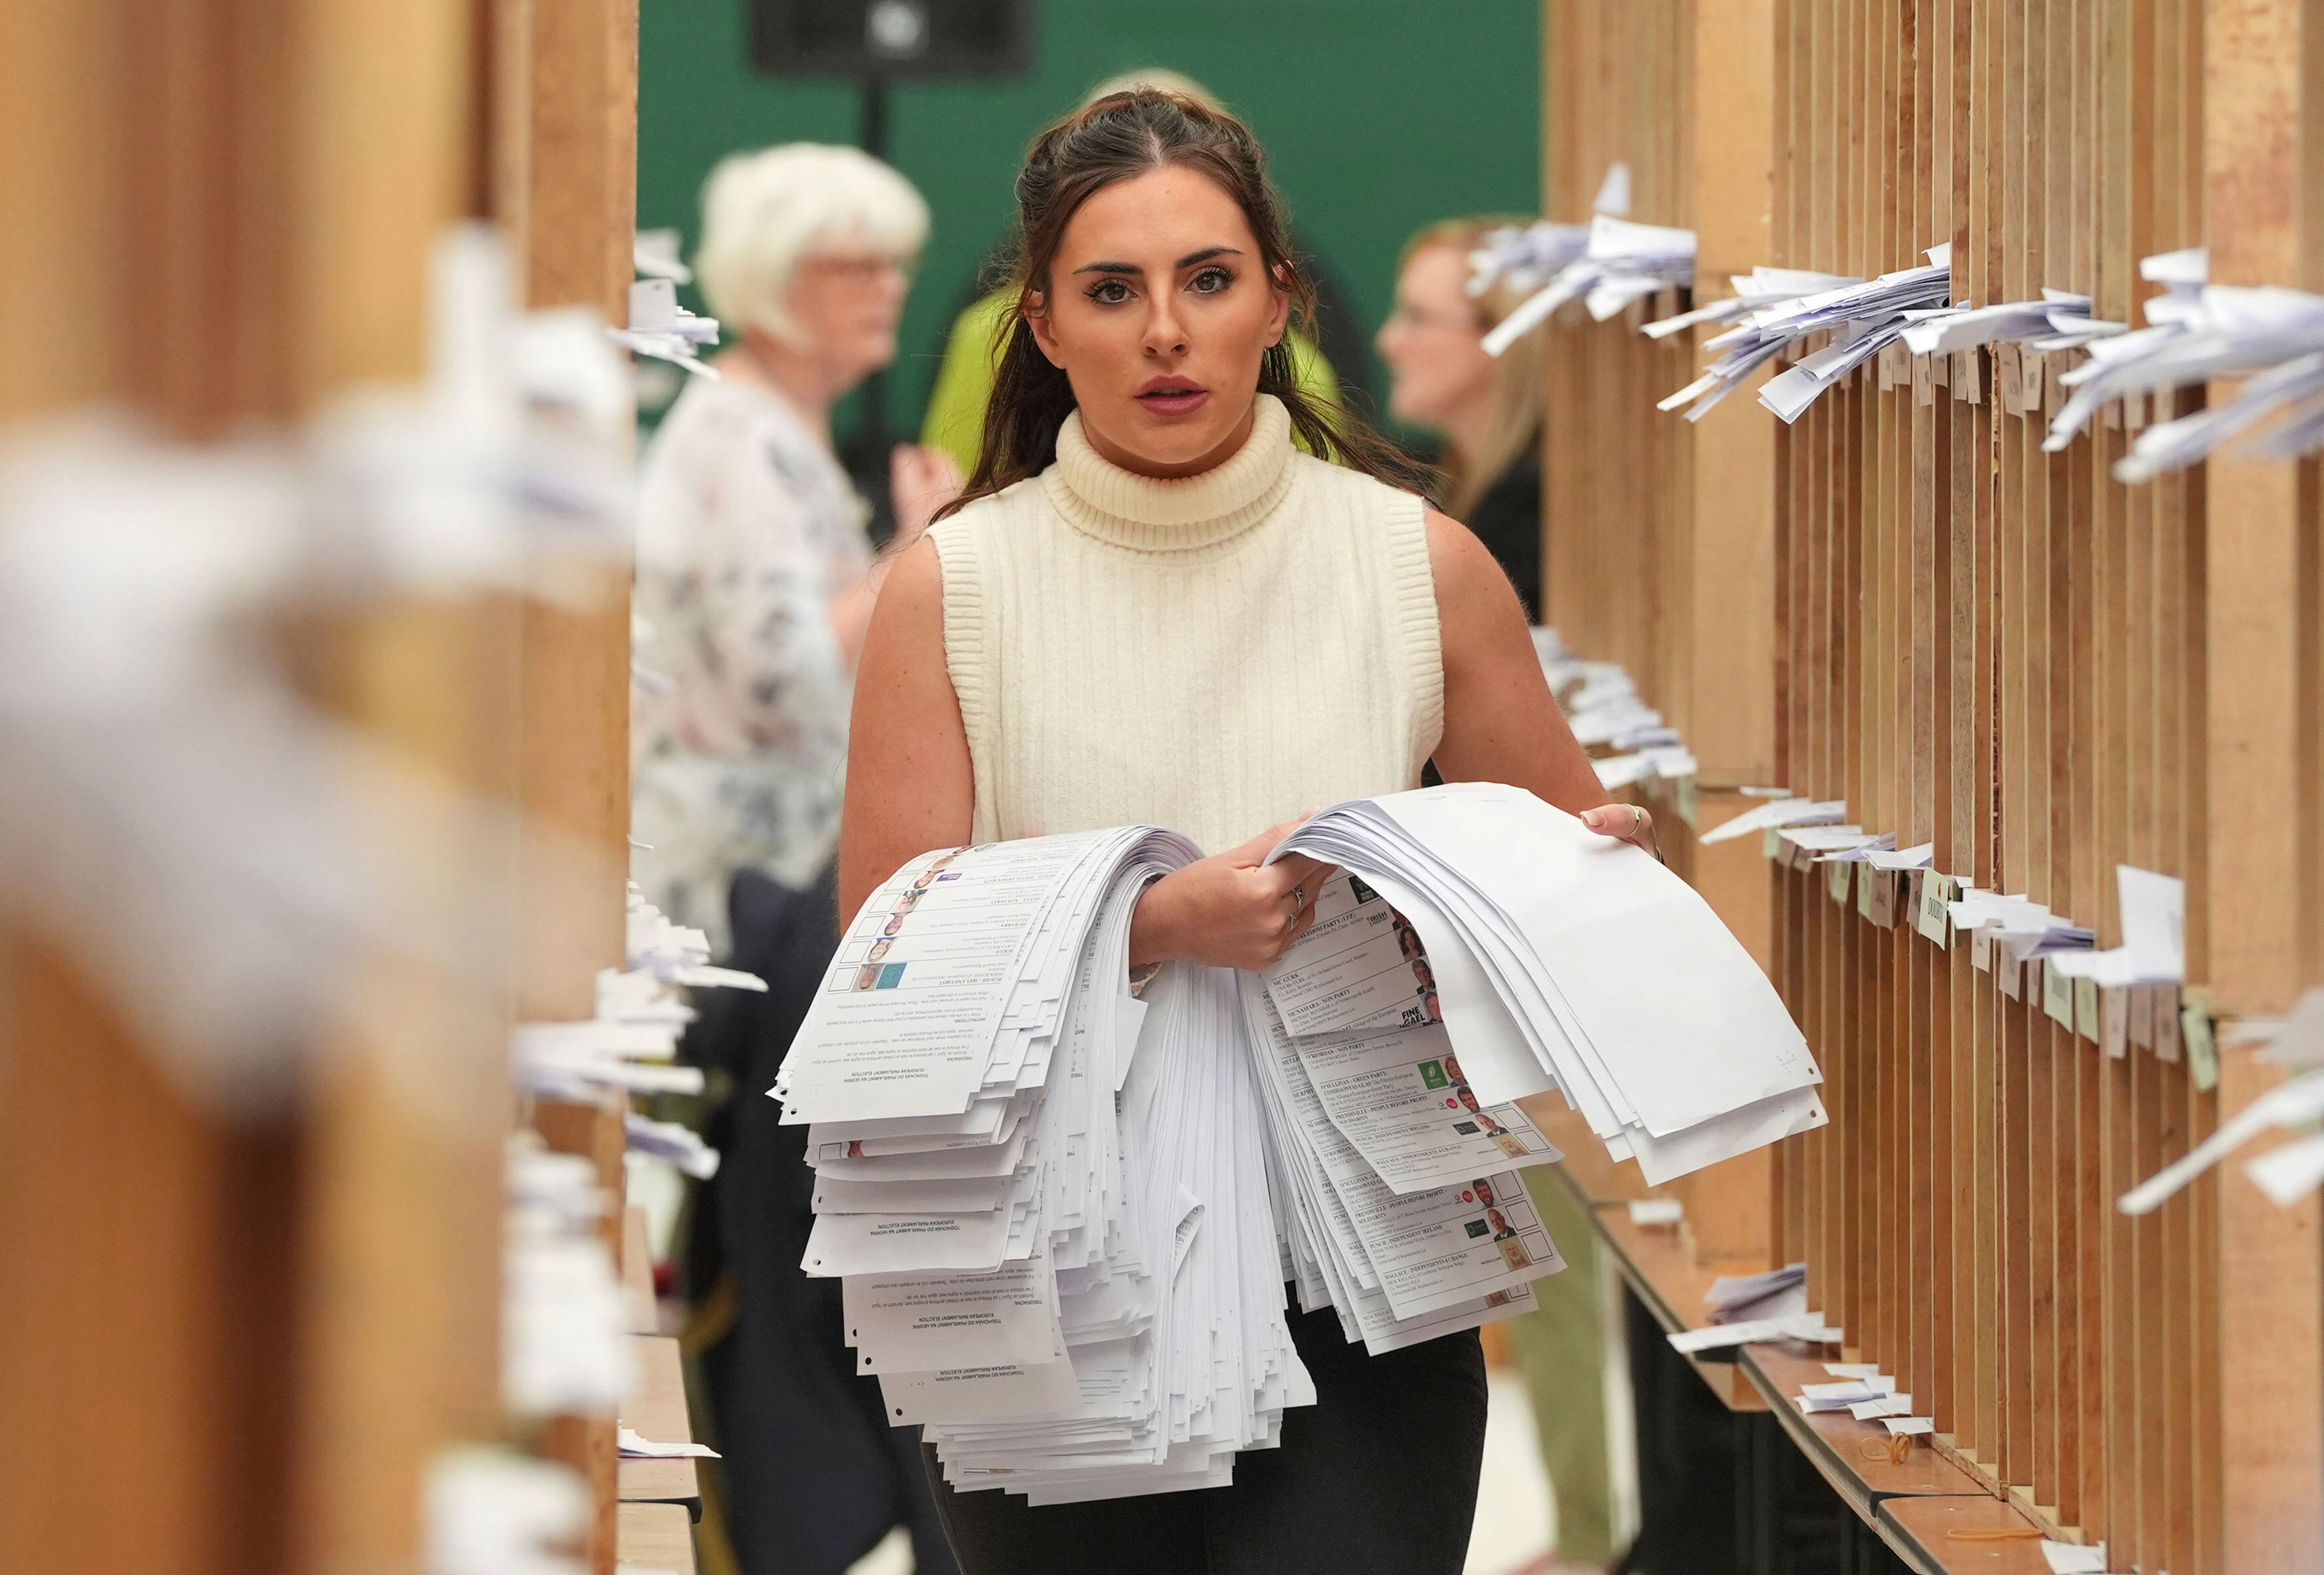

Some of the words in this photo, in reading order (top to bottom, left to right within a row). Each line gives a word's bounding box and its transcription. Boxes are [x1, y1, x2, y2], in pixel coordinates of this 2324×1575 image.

[1402, 1007, 1420, 1019] FINE
[1403, 1014, 1425, 1027] GAEL
[1369, 1240, 1390, 1249] PUNCH
[1391, 1229, 1425, 1242] INDEPENDENT
[1423, 1225, 1443, 1234] IRELAND
